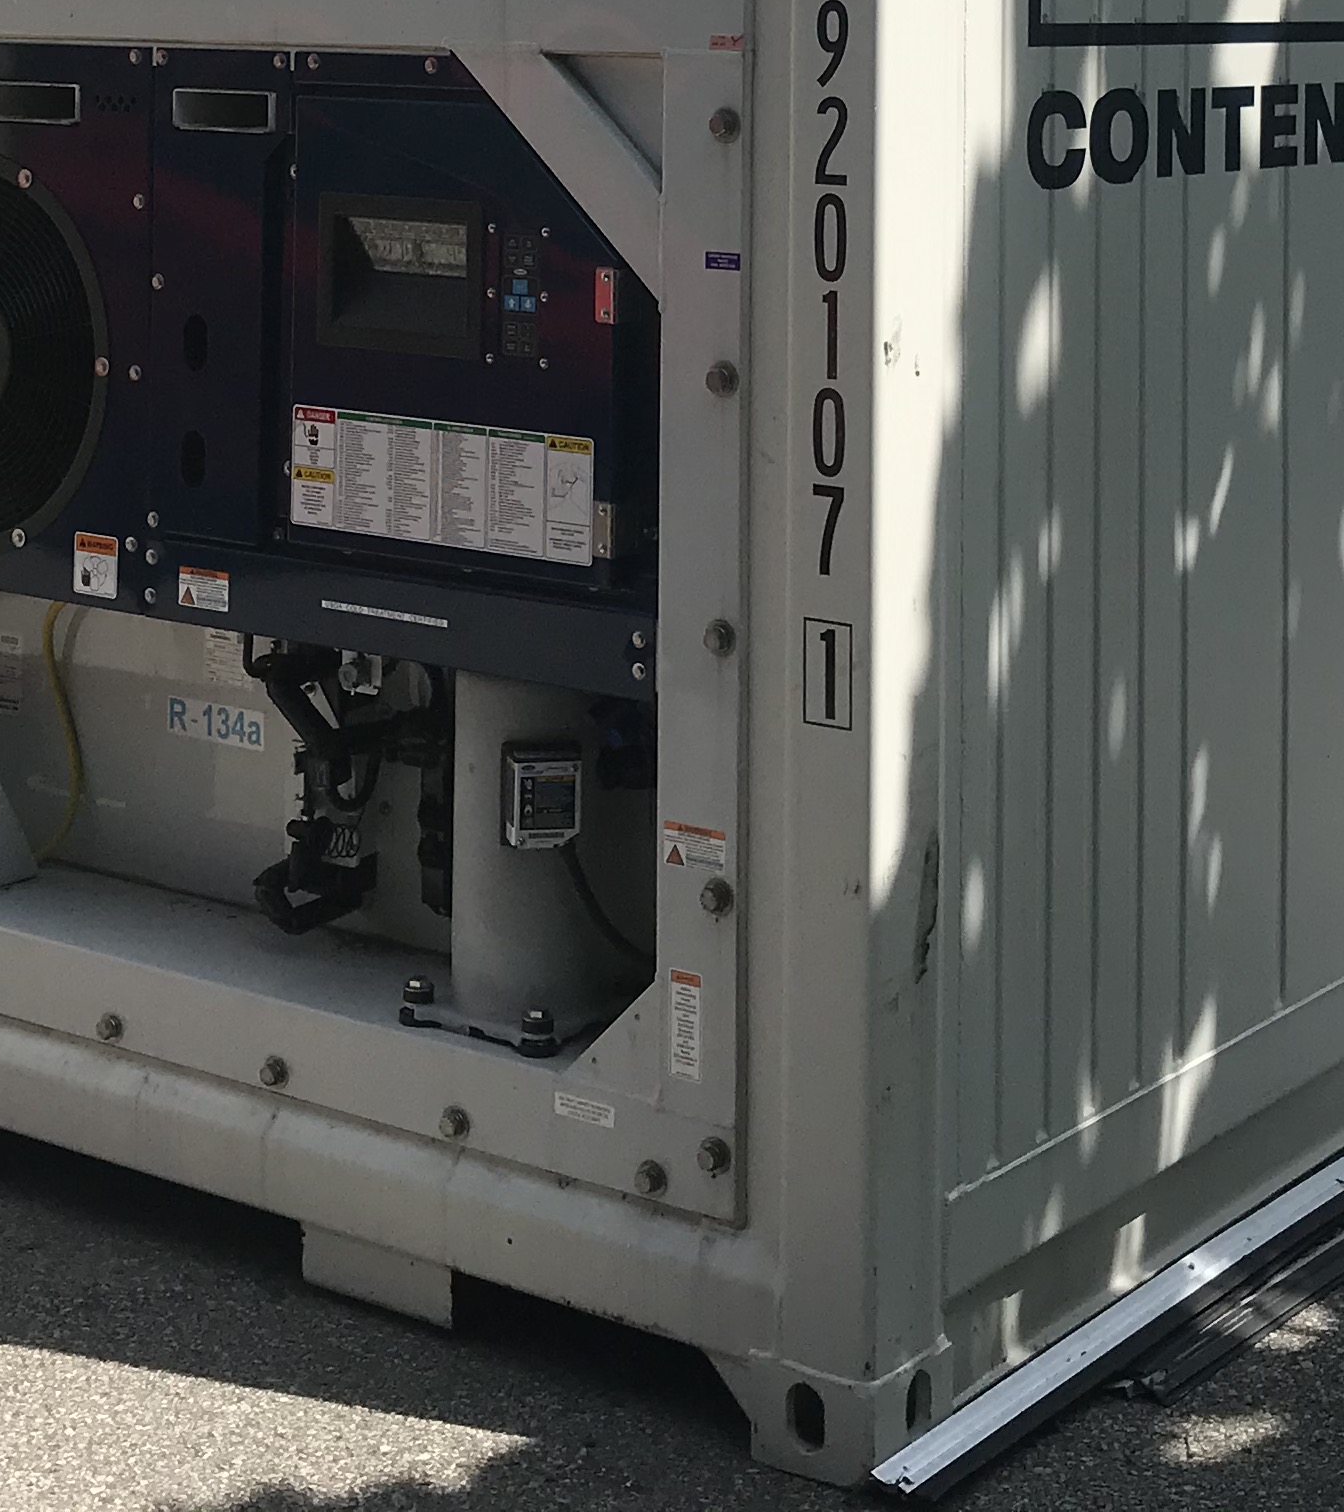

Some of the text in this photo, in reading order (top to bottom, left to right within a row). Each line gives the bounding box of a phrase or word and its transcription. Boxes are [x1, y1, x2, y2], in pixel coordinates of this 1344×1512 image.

[306, 410, 331, 422] DANGER
[558, 440, 590, 452] CAUTION
[304, 470, 332, 481] CAUTION
[819, 628, 837, 721] 1
[168, 697, 263, 746] R-134a
